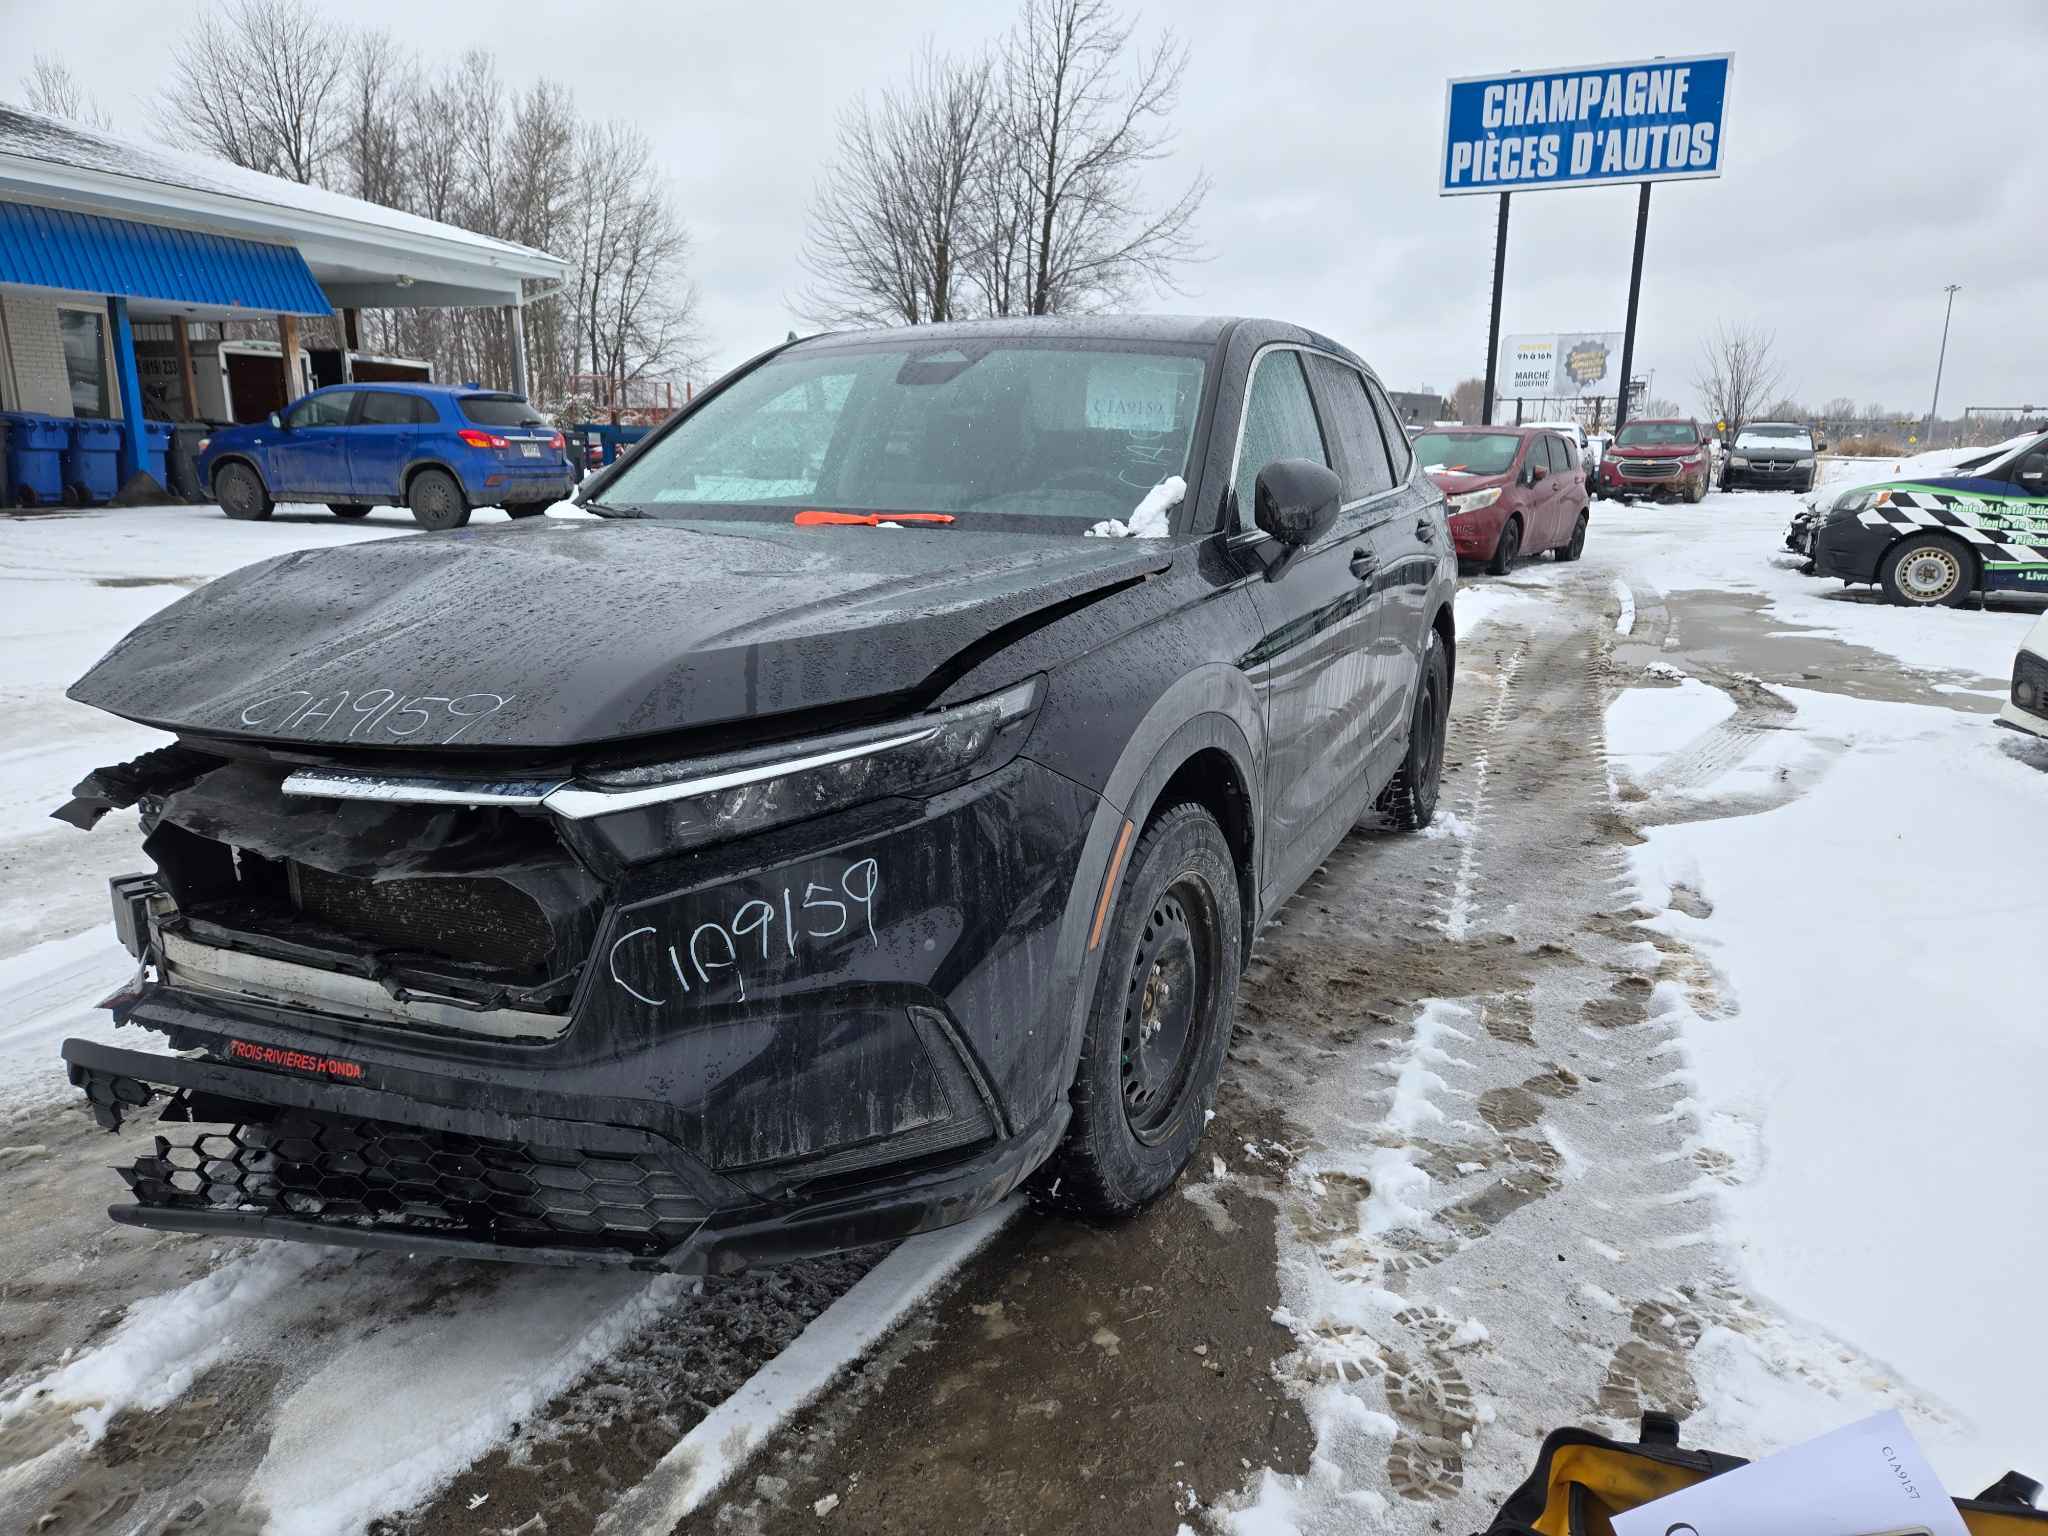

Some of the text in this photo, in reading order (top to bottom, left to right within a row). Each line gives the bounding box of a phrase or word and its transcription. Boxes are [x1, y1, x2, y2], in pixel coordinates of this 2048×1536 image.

[1482, 68, 1691, 129] CHAMPAGNE
[1450, 122, 1715, 183] PIÈCES D'AUTOS
[1515, 369, 1551, 380] MARCHÉ
